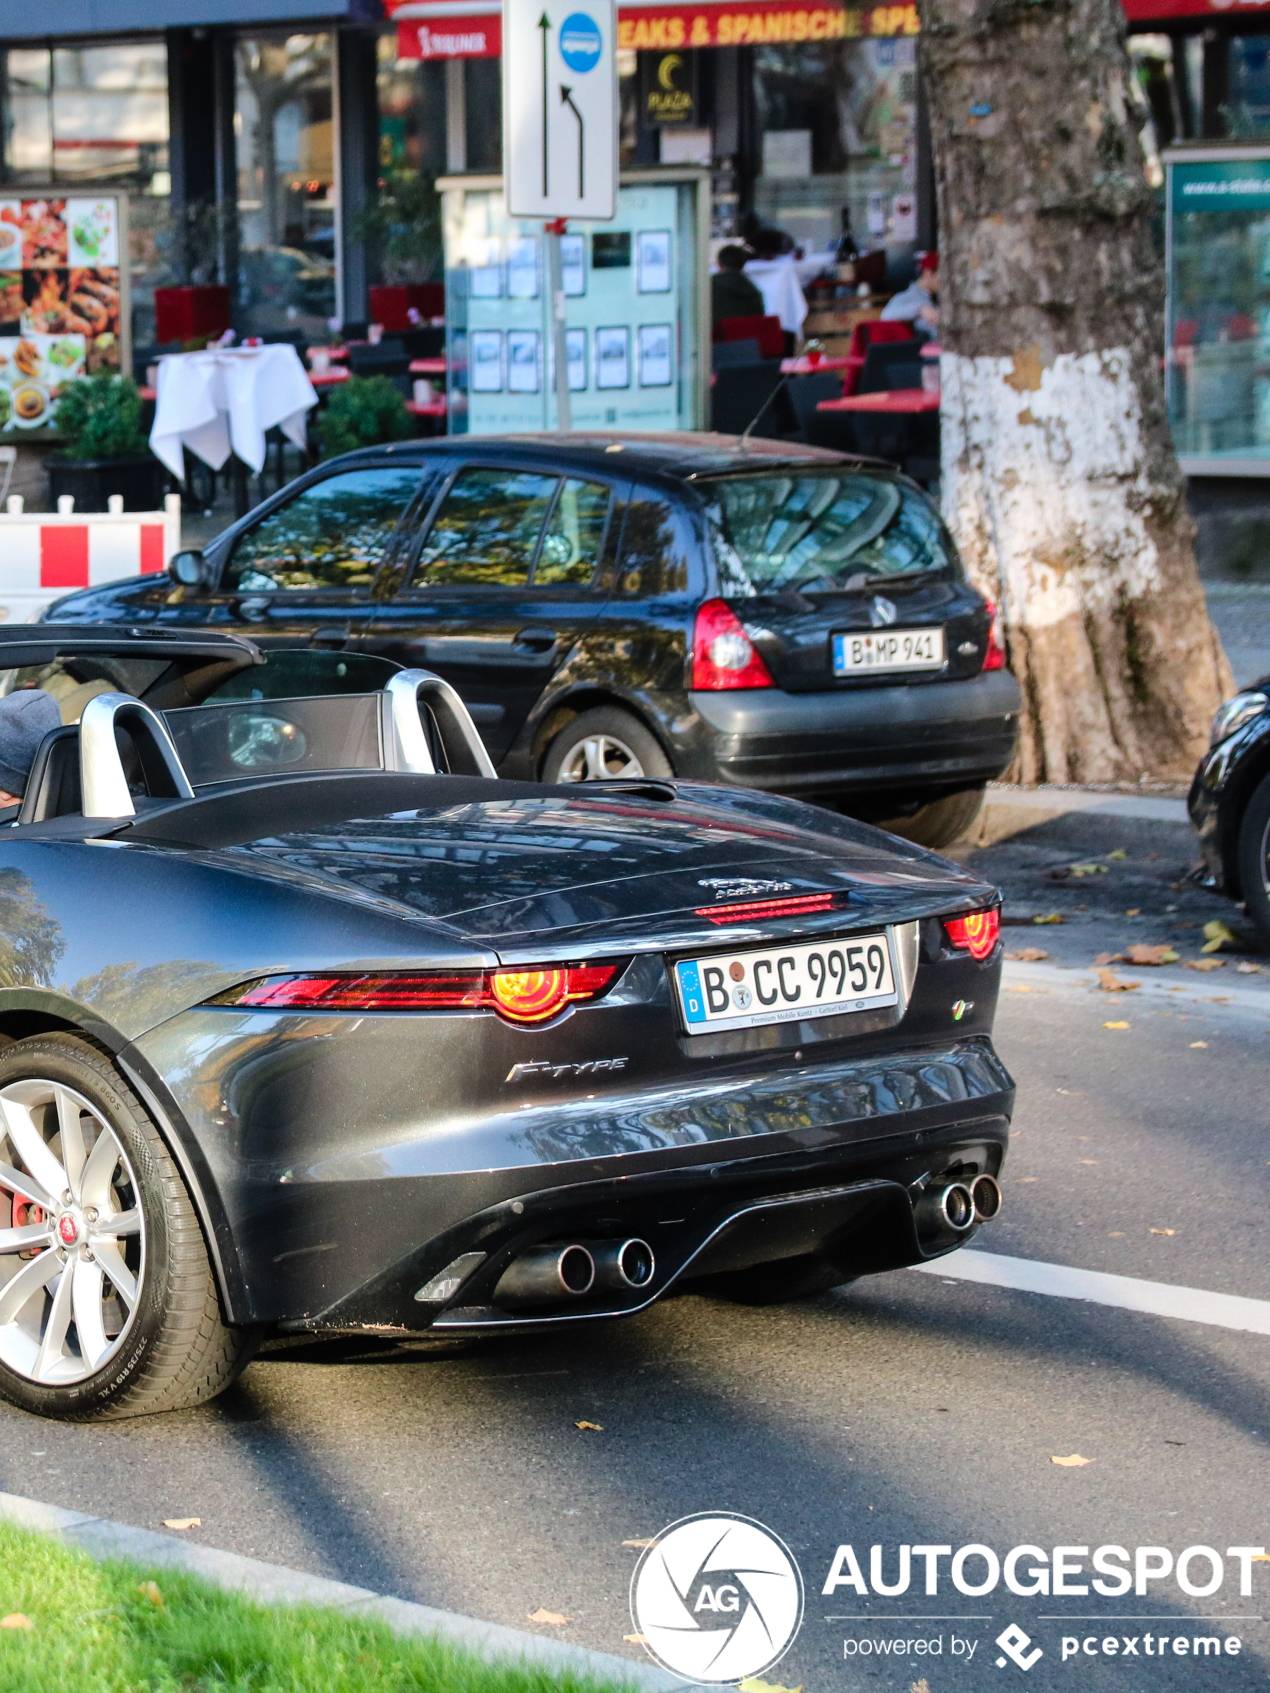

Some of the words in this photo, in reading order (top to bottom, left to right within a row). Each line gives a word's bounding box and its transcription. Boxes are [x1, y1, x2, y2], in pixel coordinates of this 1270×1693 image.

[691, 15, 710, 46] &
[717, 9, 860, 43] SPANISCHE
[852, 640, 863, 664] B
[876, 638, 898, 662] MP
[903, 636, 934, 660] 941
[689, 998, 699, 1013] D
[703, 967, 730, 1013] B
[753, 956, 801, 1006] CC
[807, 944, 885, 998] 9959
[751, 1015, 777, 1024] Premium
[777, 1011, 797, 1021] Mobile
[505, 1057, 629, 1082] F-TYPE
[127, 1336, 148, 1370] 275/35
[116, 1367, 130, 1384] R19
[98, 1387, 111, 1398] XL
